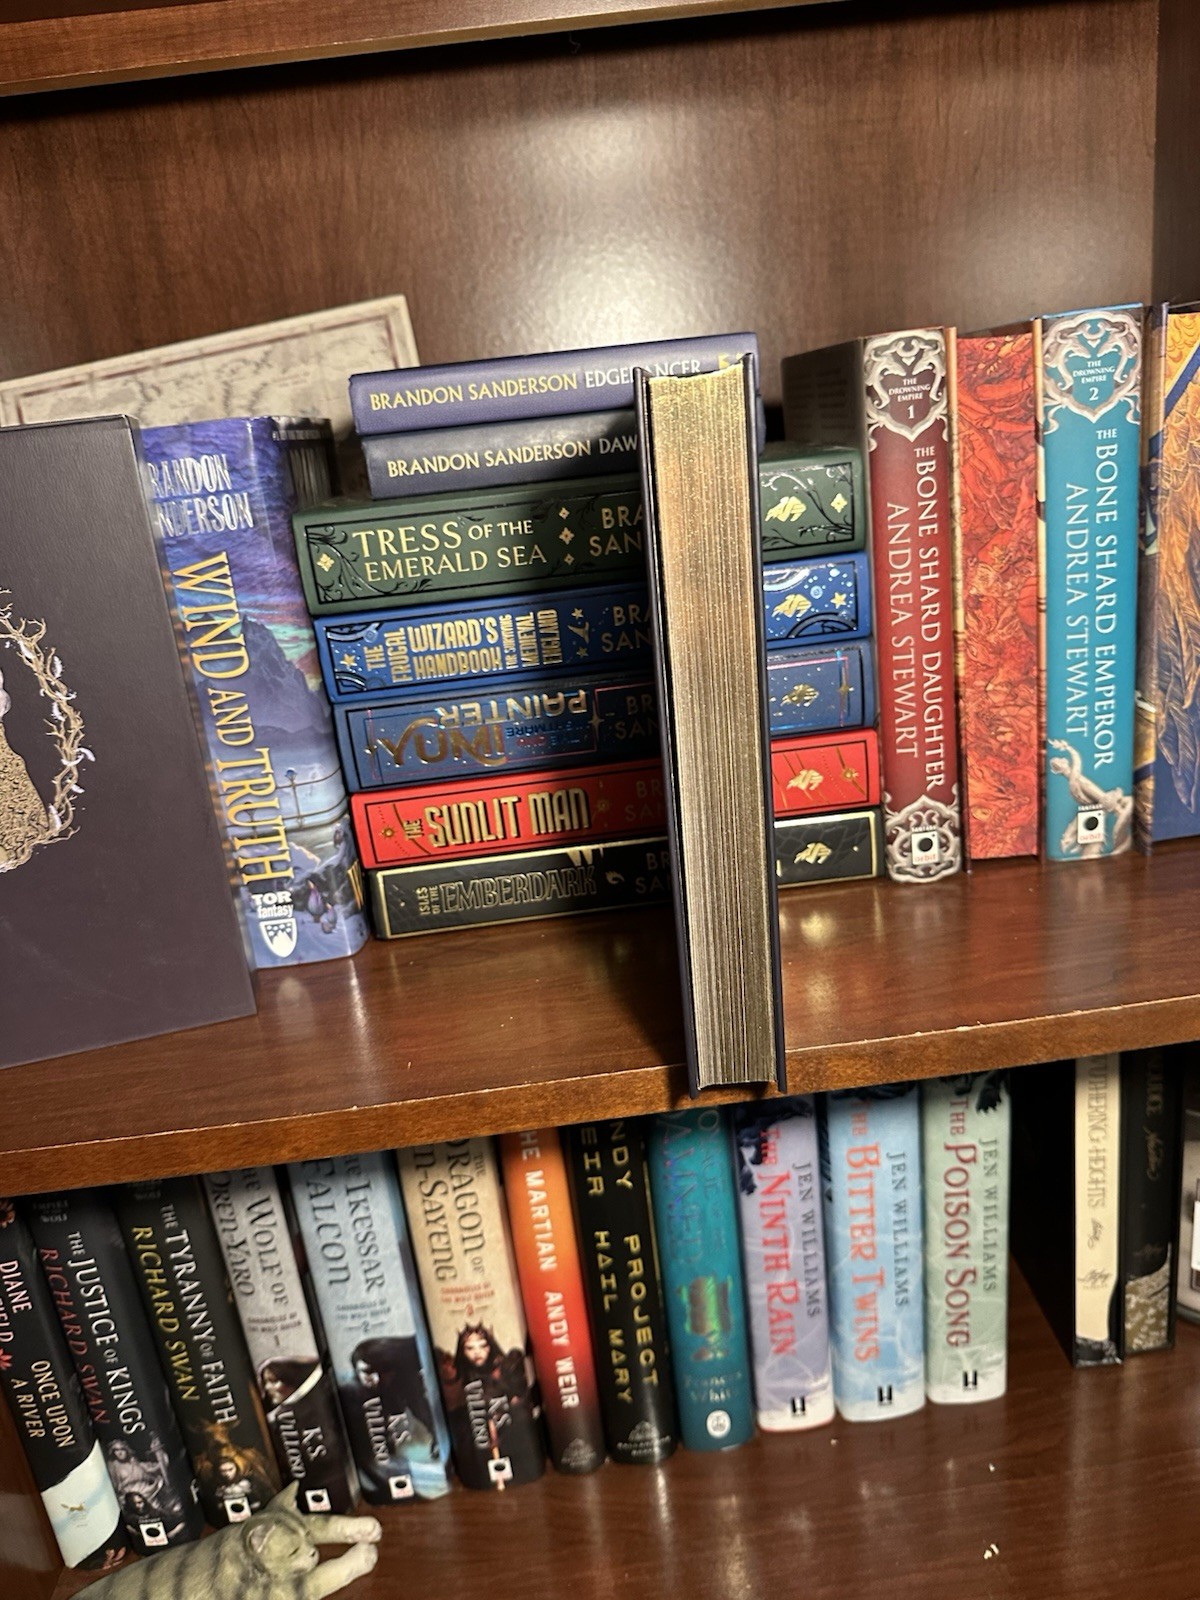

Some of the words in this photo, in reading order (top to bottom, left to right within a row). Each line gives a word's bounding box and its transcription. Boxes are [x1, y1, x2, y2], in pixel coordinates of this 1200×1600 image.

[370, 385, 464, 411] BRANDON
[469, 372, 577, 401] SANDERSON
[888, 384, 931, 395] DROWNING
[902, 378, 917, 386] THE
[1073, 366, 1116, 377] DROWNING
[1081, 375, 1107, 384] EMPIRE
[1087, 360, 1102, 368] THE
[897, 392, 923, 402] EMPIRE
[907, 405, 915, 419] 1
[1089, 387, 1099, 401] 2
[387, 452, 480, 478] BRANDON
[484, 440, 591, 467] SANDERSON
[914, 445, 935, 458] THE
[1096, 428, 1118, 440] THE
[147, 453, 232, 498] RANDON
[916, 460, 939, 538] BONE
[1095, 444, 1119, 524] BONE
[154, 492, 254, 538] NDERSON
[352, 521, 463, 558] TRESS
[468, 523, 493, 540] OF
[497, 519, 534, 536] THE
[364, 549, 488, 582] EMERALD
[497, 544, 547, 568] SEA
[886, 502, 914, 627] ANDREA
[1065, 483, 1090, 606] ANDREA
[918, 546, 941, 643] SHARD
[1094, 535, 1118, 634] SHARD
[172, 551, 250, 679] WIND
[407, 617, 499, 653] WIZARD'S
[515, 612, 540, 667] MEDIEVAL
[537, 609, 563, 665] ENGLAND
[364, 644, 387, 671] THE
[384, 627, 413, 683] FRUGAL
[413, 646, 503, 680] HANDBOOK
[1065, 616, 1090, 737] STEWART
[207, 687, 255, 746] AND
[436, 689, 587, 729] PAINTER
[891, 634, 919, 758] STEWART
[921, 651, 946, 792] DAUGHTER
[1093, 644, 1116, 770] EMPEROR
[377, 718, 508, 767] YUMI
[216, 747, 295, 885] TRUTH
[404, 818, 424, 840] THE
[424, 795, 521, 848] SUNLIT
[528, 787, 592, 836] MAN
[252, 891, 292, 905] TOR
[257, 903, 294, 919] fantasy
[416, 886, 432, 915] ISLES
[429, 885, 439, 901] THE
[439, 865, 597, 913] EMBERDARK
[949, 1096, 970, 1136] THE
[519, 1131, 541, 1161] HE
[581, 1127, 605, 1196] EIR
[609, 1121, 634, 1190] NDY
[759, 1127, 781, 1165] THE
[886, 1151, 907, 1193] JEN
[979, 1138, 999, 1183] JEN
[792, 1162, 814, 1202] JEN
[846, 1142, 882, 1262] BITTER
[943, 1142, 979, 1259] POISON
[1087, 1147, 1107, 1210] HEIGHTS
[160, 1204, 179, 1229] THE
[345, 1180, 386, 1293] IKESSAR
[413, 1148, 458, 1281] N-SAYENG
[525, 1169, 559, 1271] MARTIAN
[757, 1170, 793, 1273] NINTH
[982, 1187, 999, 1293] WILLIAMS
[67, 1230, 86, 1256] THE
[246, 1195, 283, 1276] WOLF
[270, 1282, 289, 1305] OF
[471, 1257, 485, 1275] OF
[801, 1208, 822, 1319] WILLIAMS
[892, 1198, 911, 1308] WILLIAMS
[0, 1260, 33, 1314] DIANE
[67, 1258, 119, 1347] JUSTICE
[131, 1225, 181, 1336] RICHARD
[164, 1338, 201, 1403] SWAN
[165, 1229, 216, 1348] TYRANNY
[623, 1233, 660, 1388] PROJECT
[851, 1265, 885, 1363] TWINS
[945, 1265, 980, 1349] SONG
[40, 1248, 88, 1356] RICHARD
[77, 1363, 111, 1424] SWAN
[544, 1290, 570, 1348] ANDY
[593, 1230, 620, 1312] HAIL
[608, 1328, 634, 1405] MARY
[766, 1279, 800, 1356] RAIN
[103, 1347, 118, 1365] OF
[201, 1341, 215, 1359] OF
[11, 1378, 29, 1390] A
[30, 1360, 61, 1402] ONCE
[105, 1366, 146, 1436] KINGS
[201, 1359, 239, 1426] FAITH
[555, 1355, 581, 1410] WEIR
[17, 1392, 46, 1438] RIVER
[45, 1402, 76, 1448] UPON
[362, 1396, 390, 1466] VILLOSO
[464, 1378, 491, 1450] VILLOSO
[277, 1410, 307, 1479] VILLOSO
